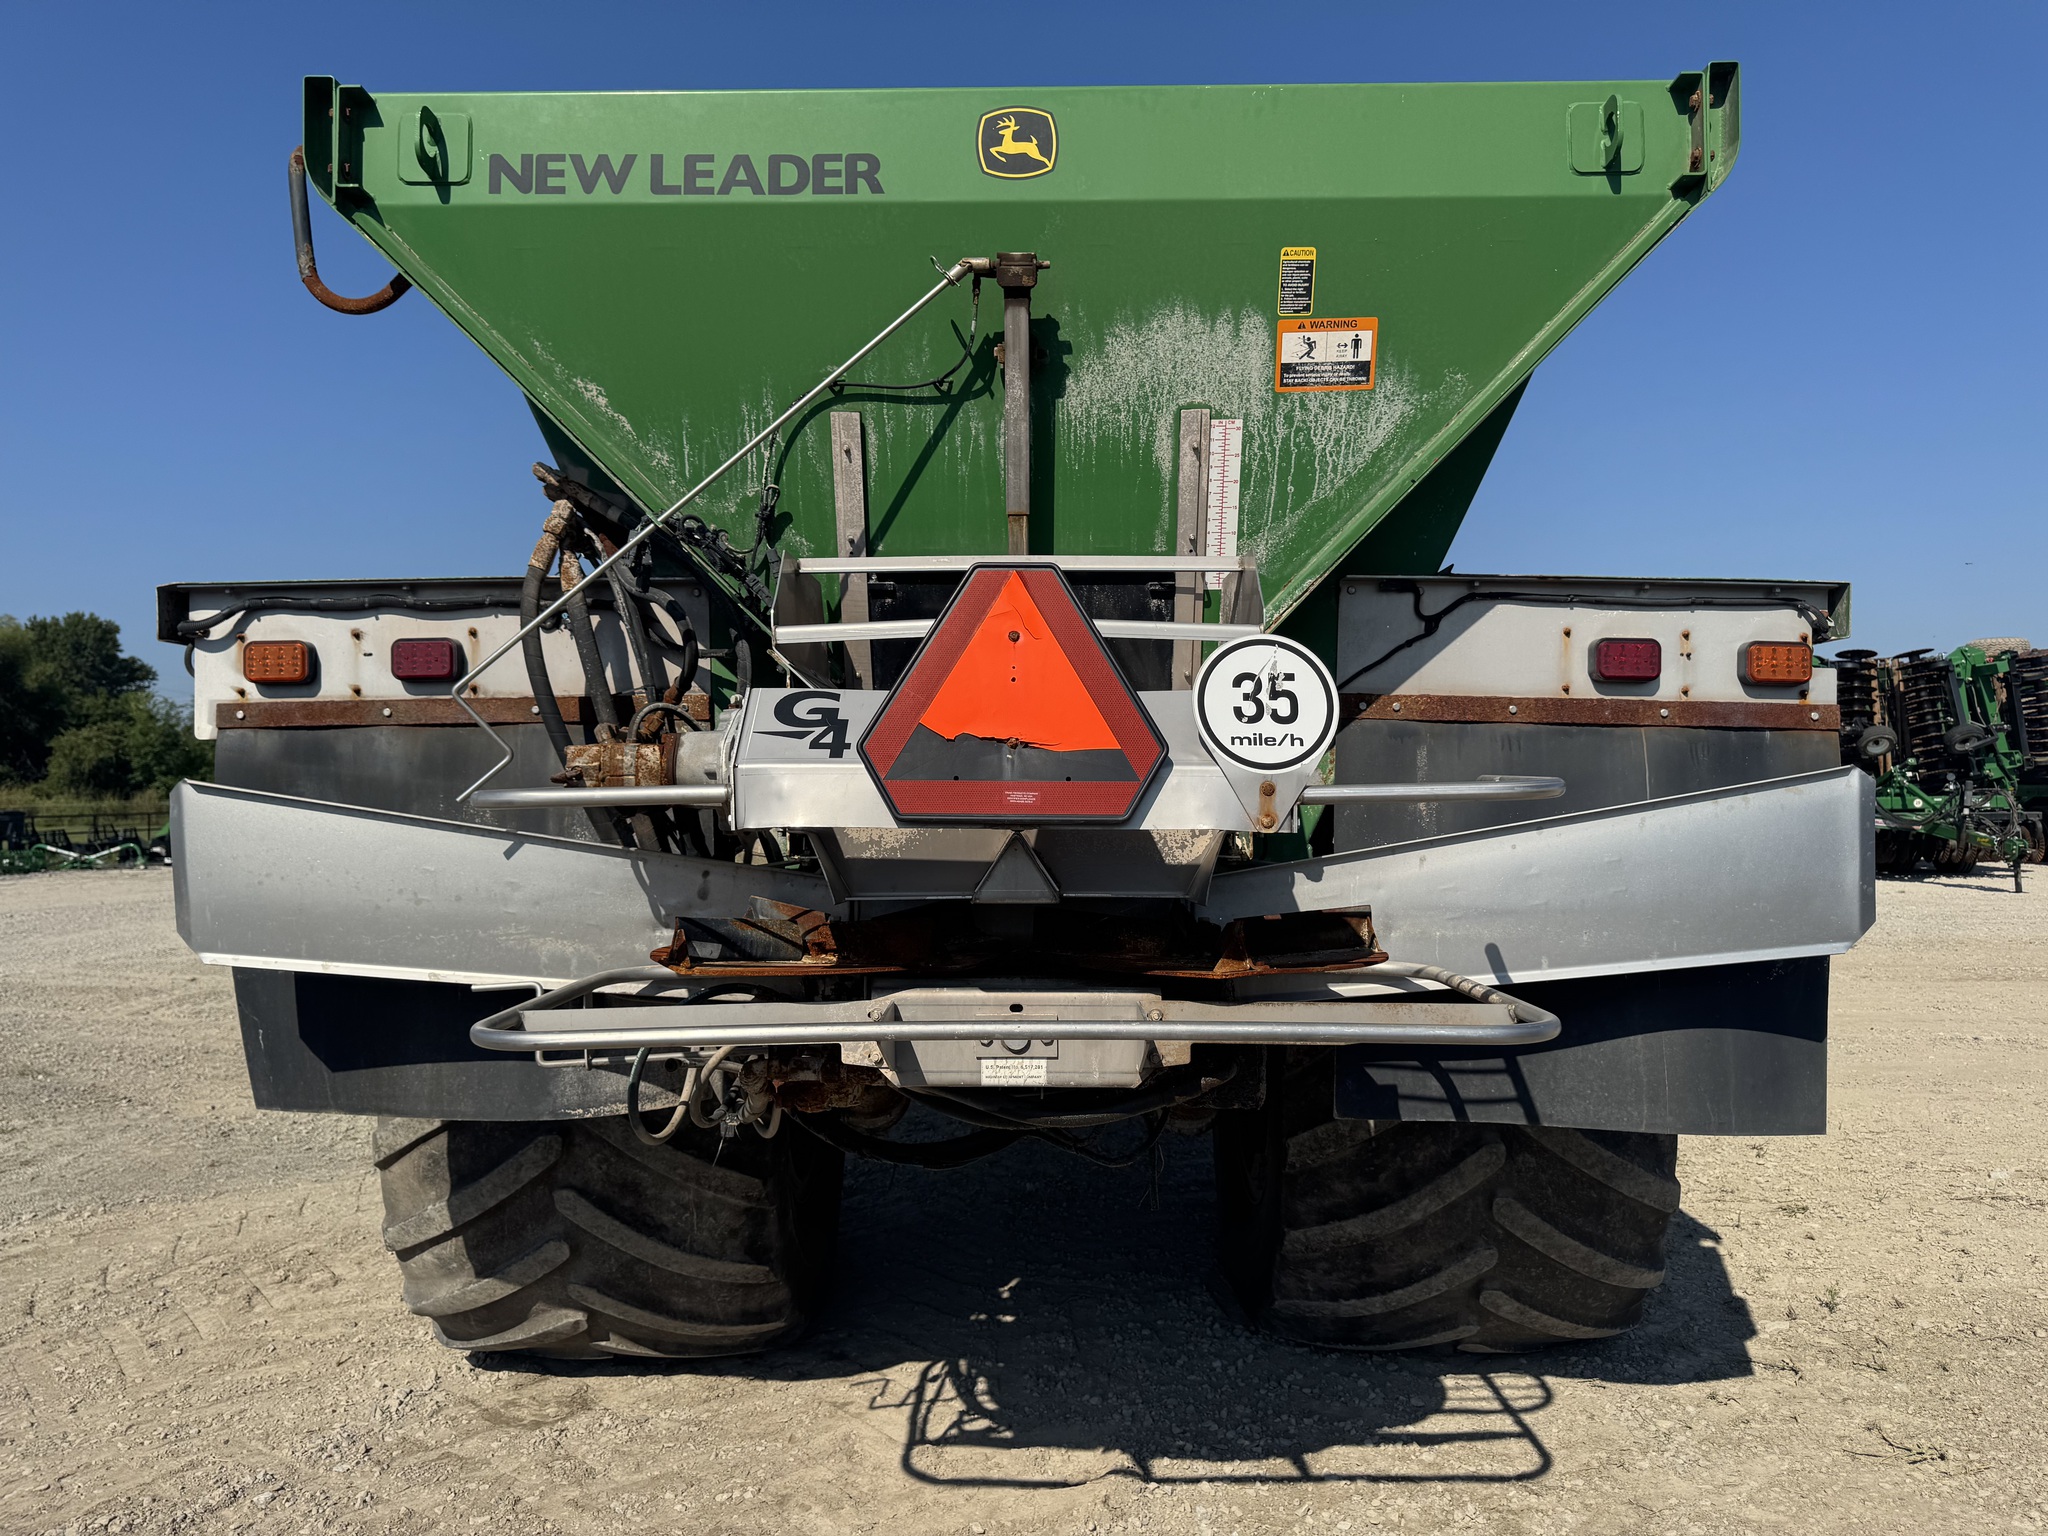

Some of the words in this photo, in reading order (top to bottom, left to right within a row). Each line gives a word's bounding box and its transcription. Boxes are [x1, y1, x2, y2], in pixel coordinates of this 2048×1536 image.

[488, 153, 638, 195] NEW
[649, 153, 886, 195] LEADER
[1309, 320, 1358, 329] WARNING
[1232, 671, 1299, 725] 35
[773, 690, 852, 759] G4
[1230, 733, 1304, 747] mile/h
